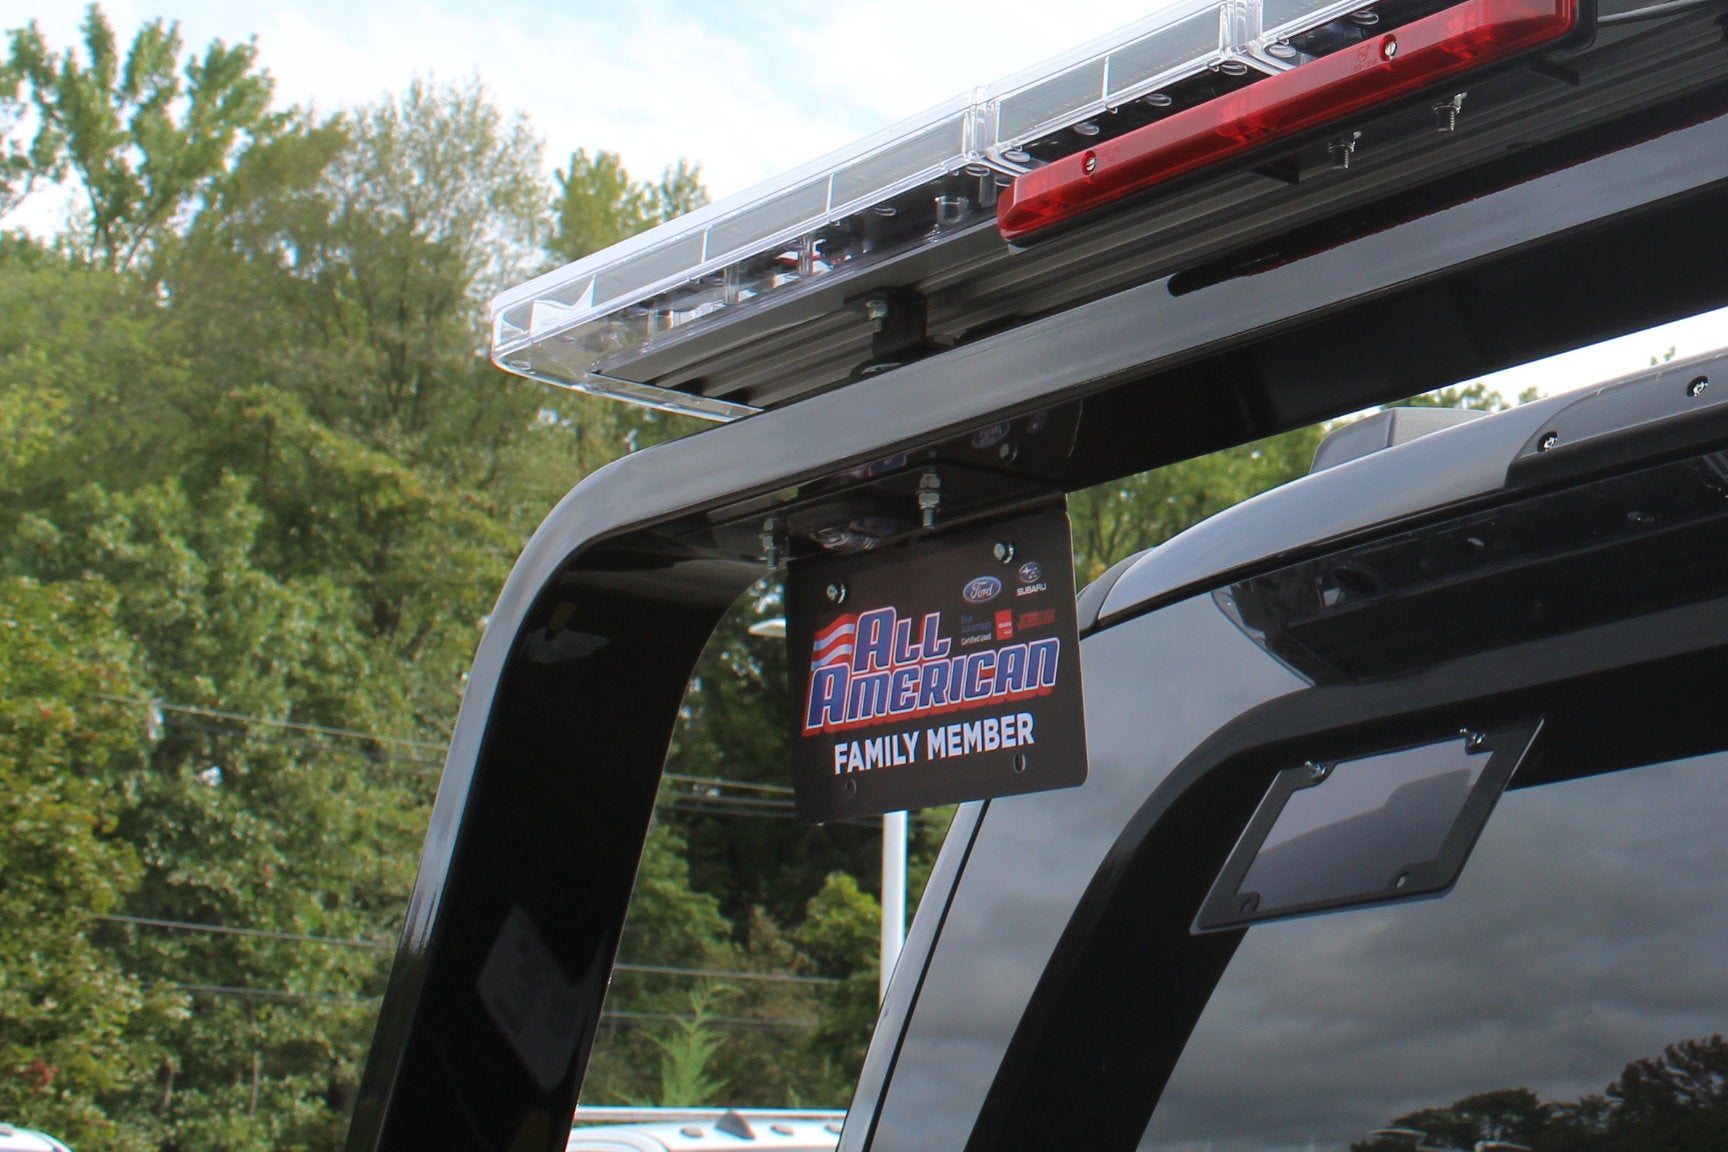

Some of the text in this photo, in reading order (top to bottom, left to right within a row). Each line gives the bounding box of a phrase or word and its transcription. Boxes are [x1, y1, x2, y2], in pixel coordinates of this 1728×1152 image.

[1016, 583, 1047, 597] SUBARU
[834, 711, 1035, 775] FAMILY MEMBER
